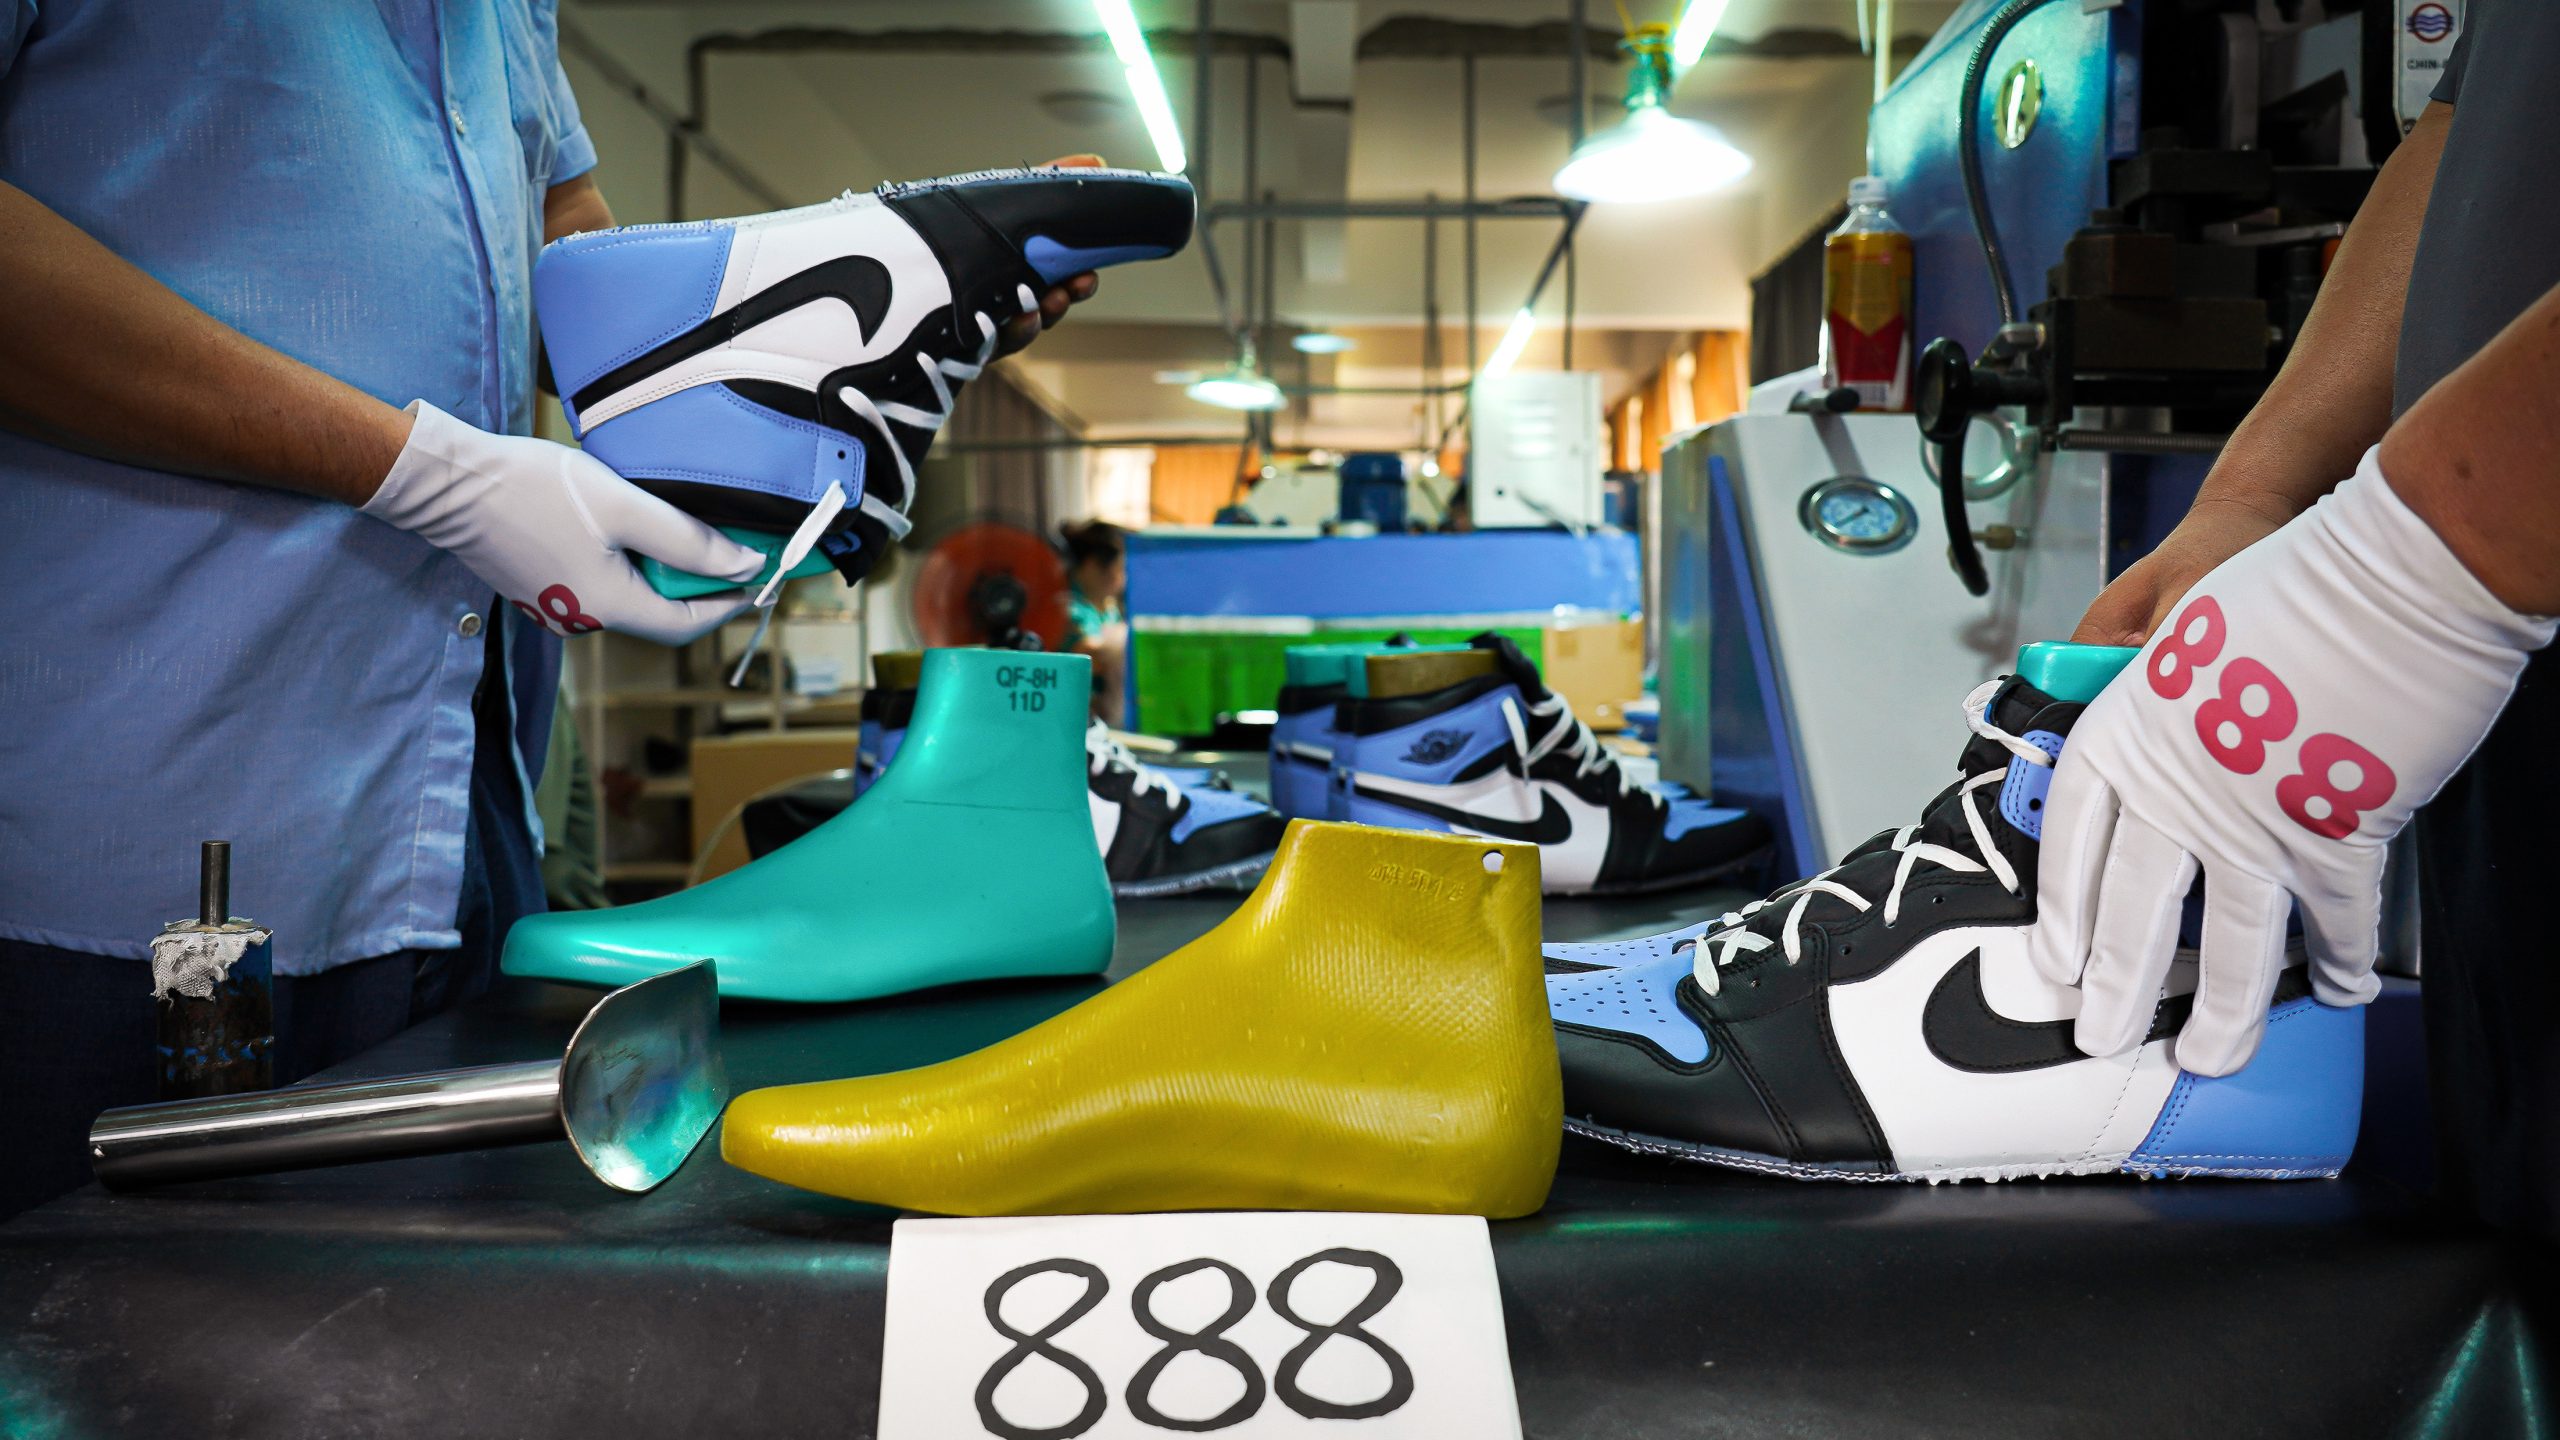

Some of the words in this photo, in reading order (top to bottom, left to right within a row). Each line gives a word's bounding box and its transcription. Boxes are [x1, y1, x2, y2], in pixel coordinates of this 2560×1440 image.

[996, 665, 1057, 689] QF-8H
[1009, 690, 1046, 713] 11D
[2147, 595, 2397, 840] 888
[975, 1247, 1414, 1440] 888
